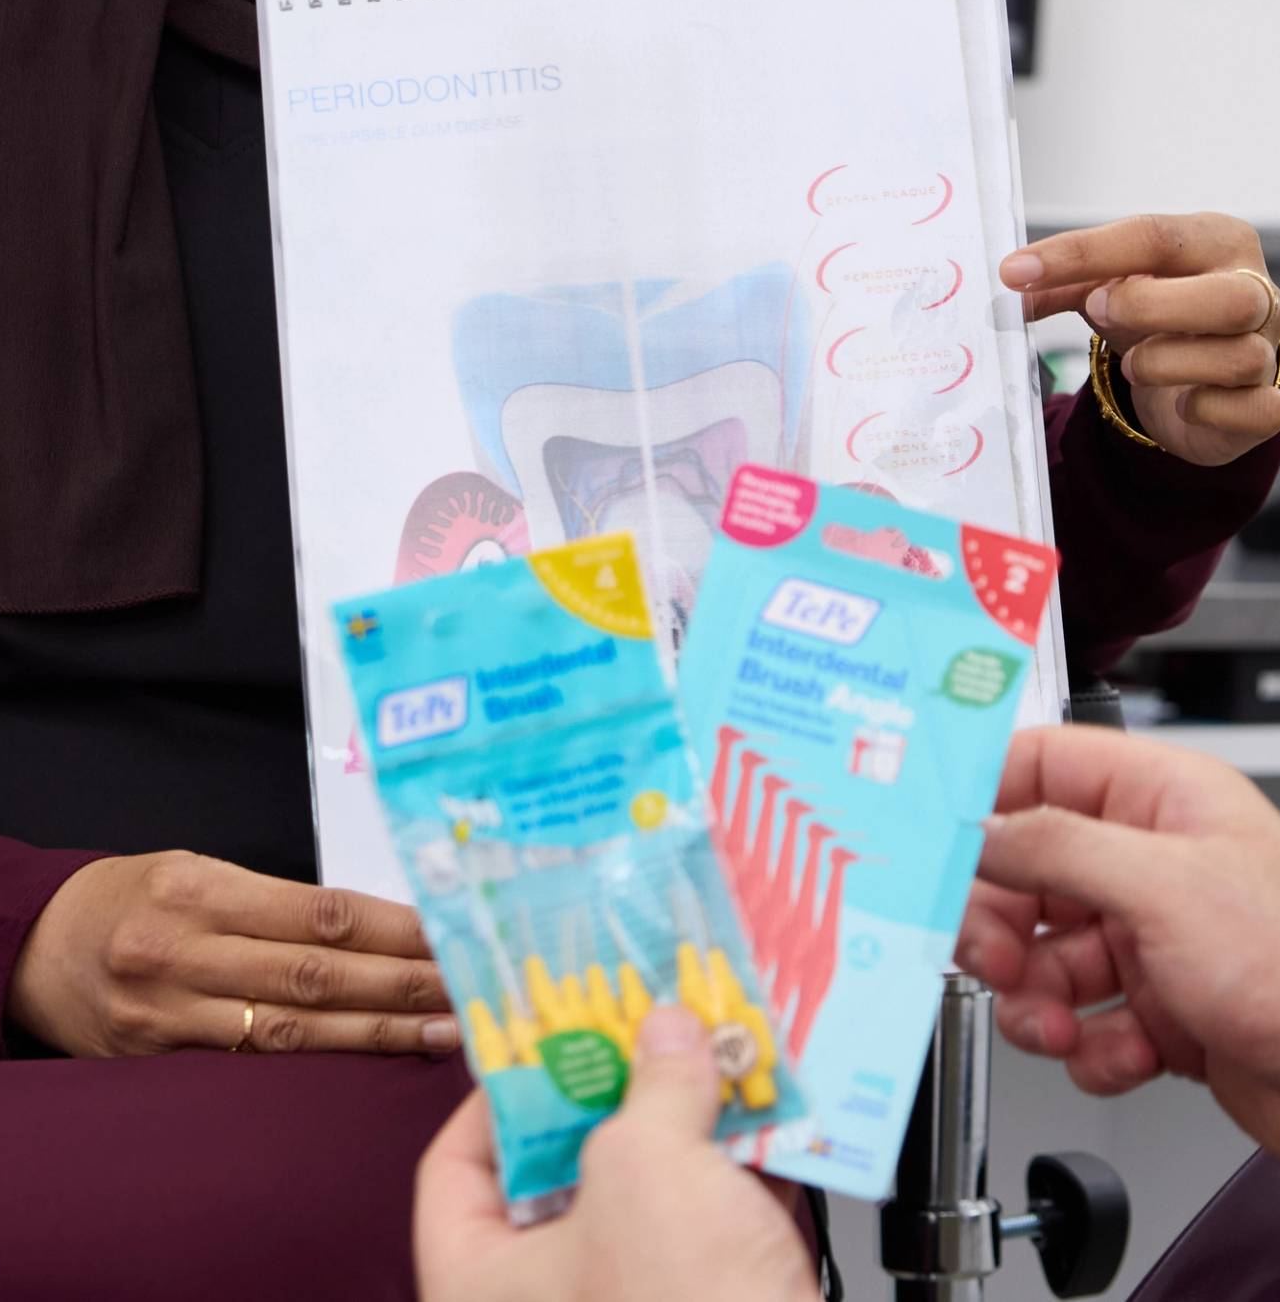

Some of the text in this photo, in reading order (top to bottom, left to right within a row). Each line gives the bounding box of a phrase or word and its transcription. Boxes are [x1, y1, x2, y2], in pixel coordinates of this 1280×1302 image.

[287, 64, 563, 113] PERIODONTITIS
[880, 185, 937, 199] PLAQUE
[843, 266, 939, 282] PERIODONTAL
[891, 441, 929, 454] BONE
[784, 590, 860, 632] TePe
[738, 657, 825, 702] Brush
[746, 626, 909, 692] Interdental
[391, 635, 616, 734] TePe Interdental
[482, 682, 564, 723] Brush
